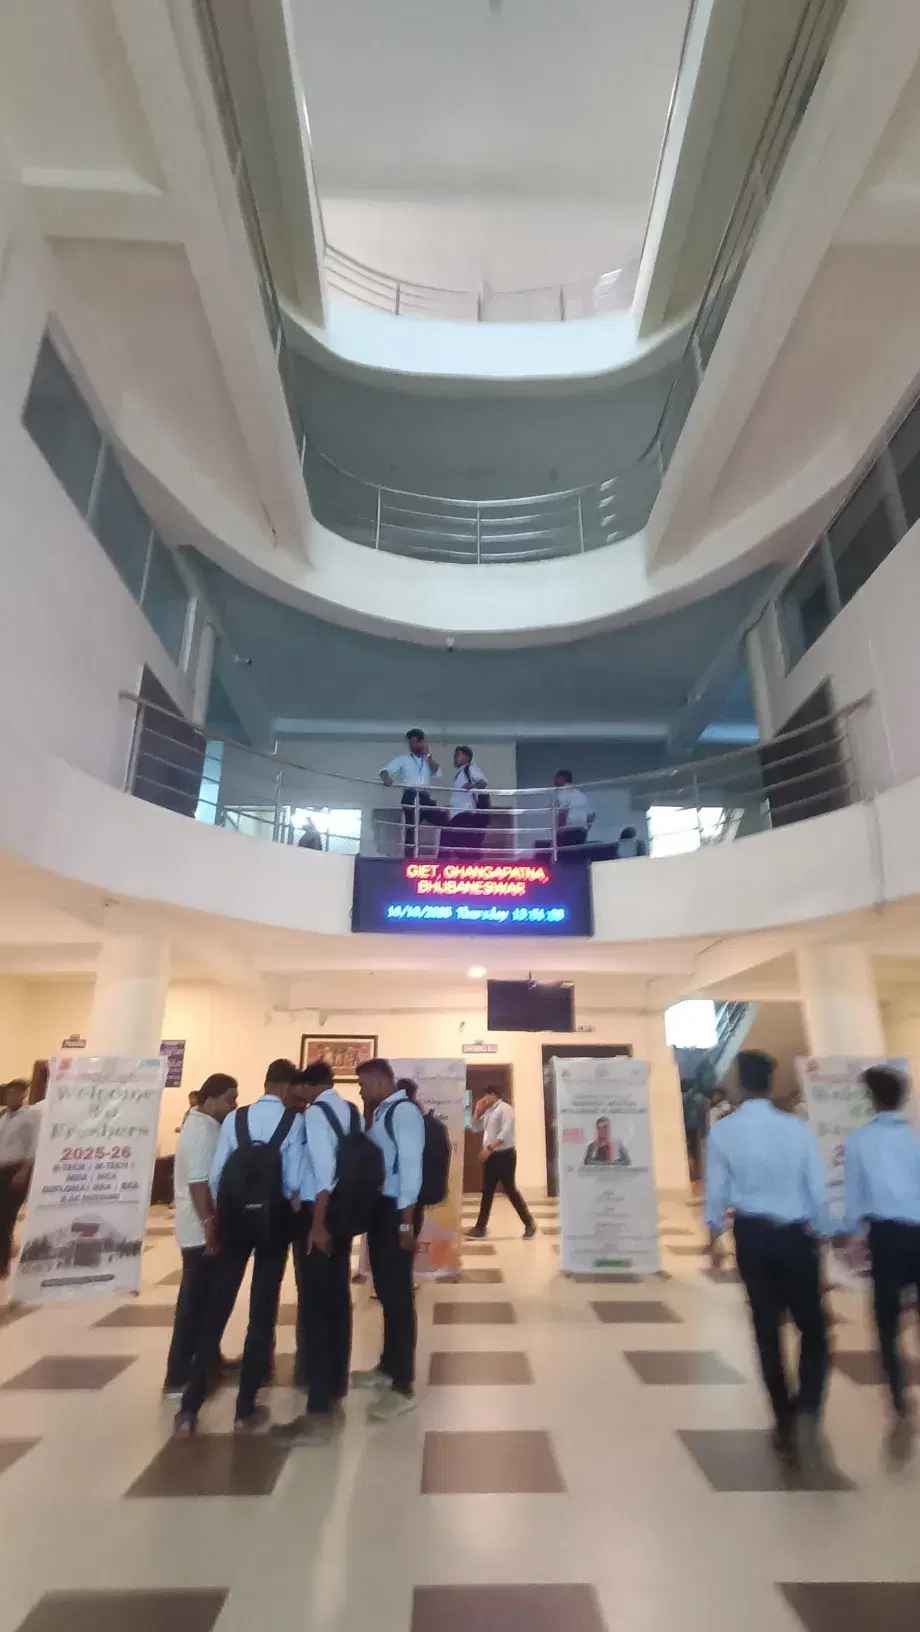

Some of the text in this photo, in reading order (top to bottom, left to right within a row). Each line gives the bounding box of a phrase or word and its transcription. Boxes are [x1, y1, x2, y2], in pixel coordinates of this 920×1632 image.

[406, 864, 441, 880] GIET,
[417, 880, 526, 896] BHUBANESWAR
[455, 905, 510, 922] Thursday
[61, 1146, 132, 1161] 2025-26
